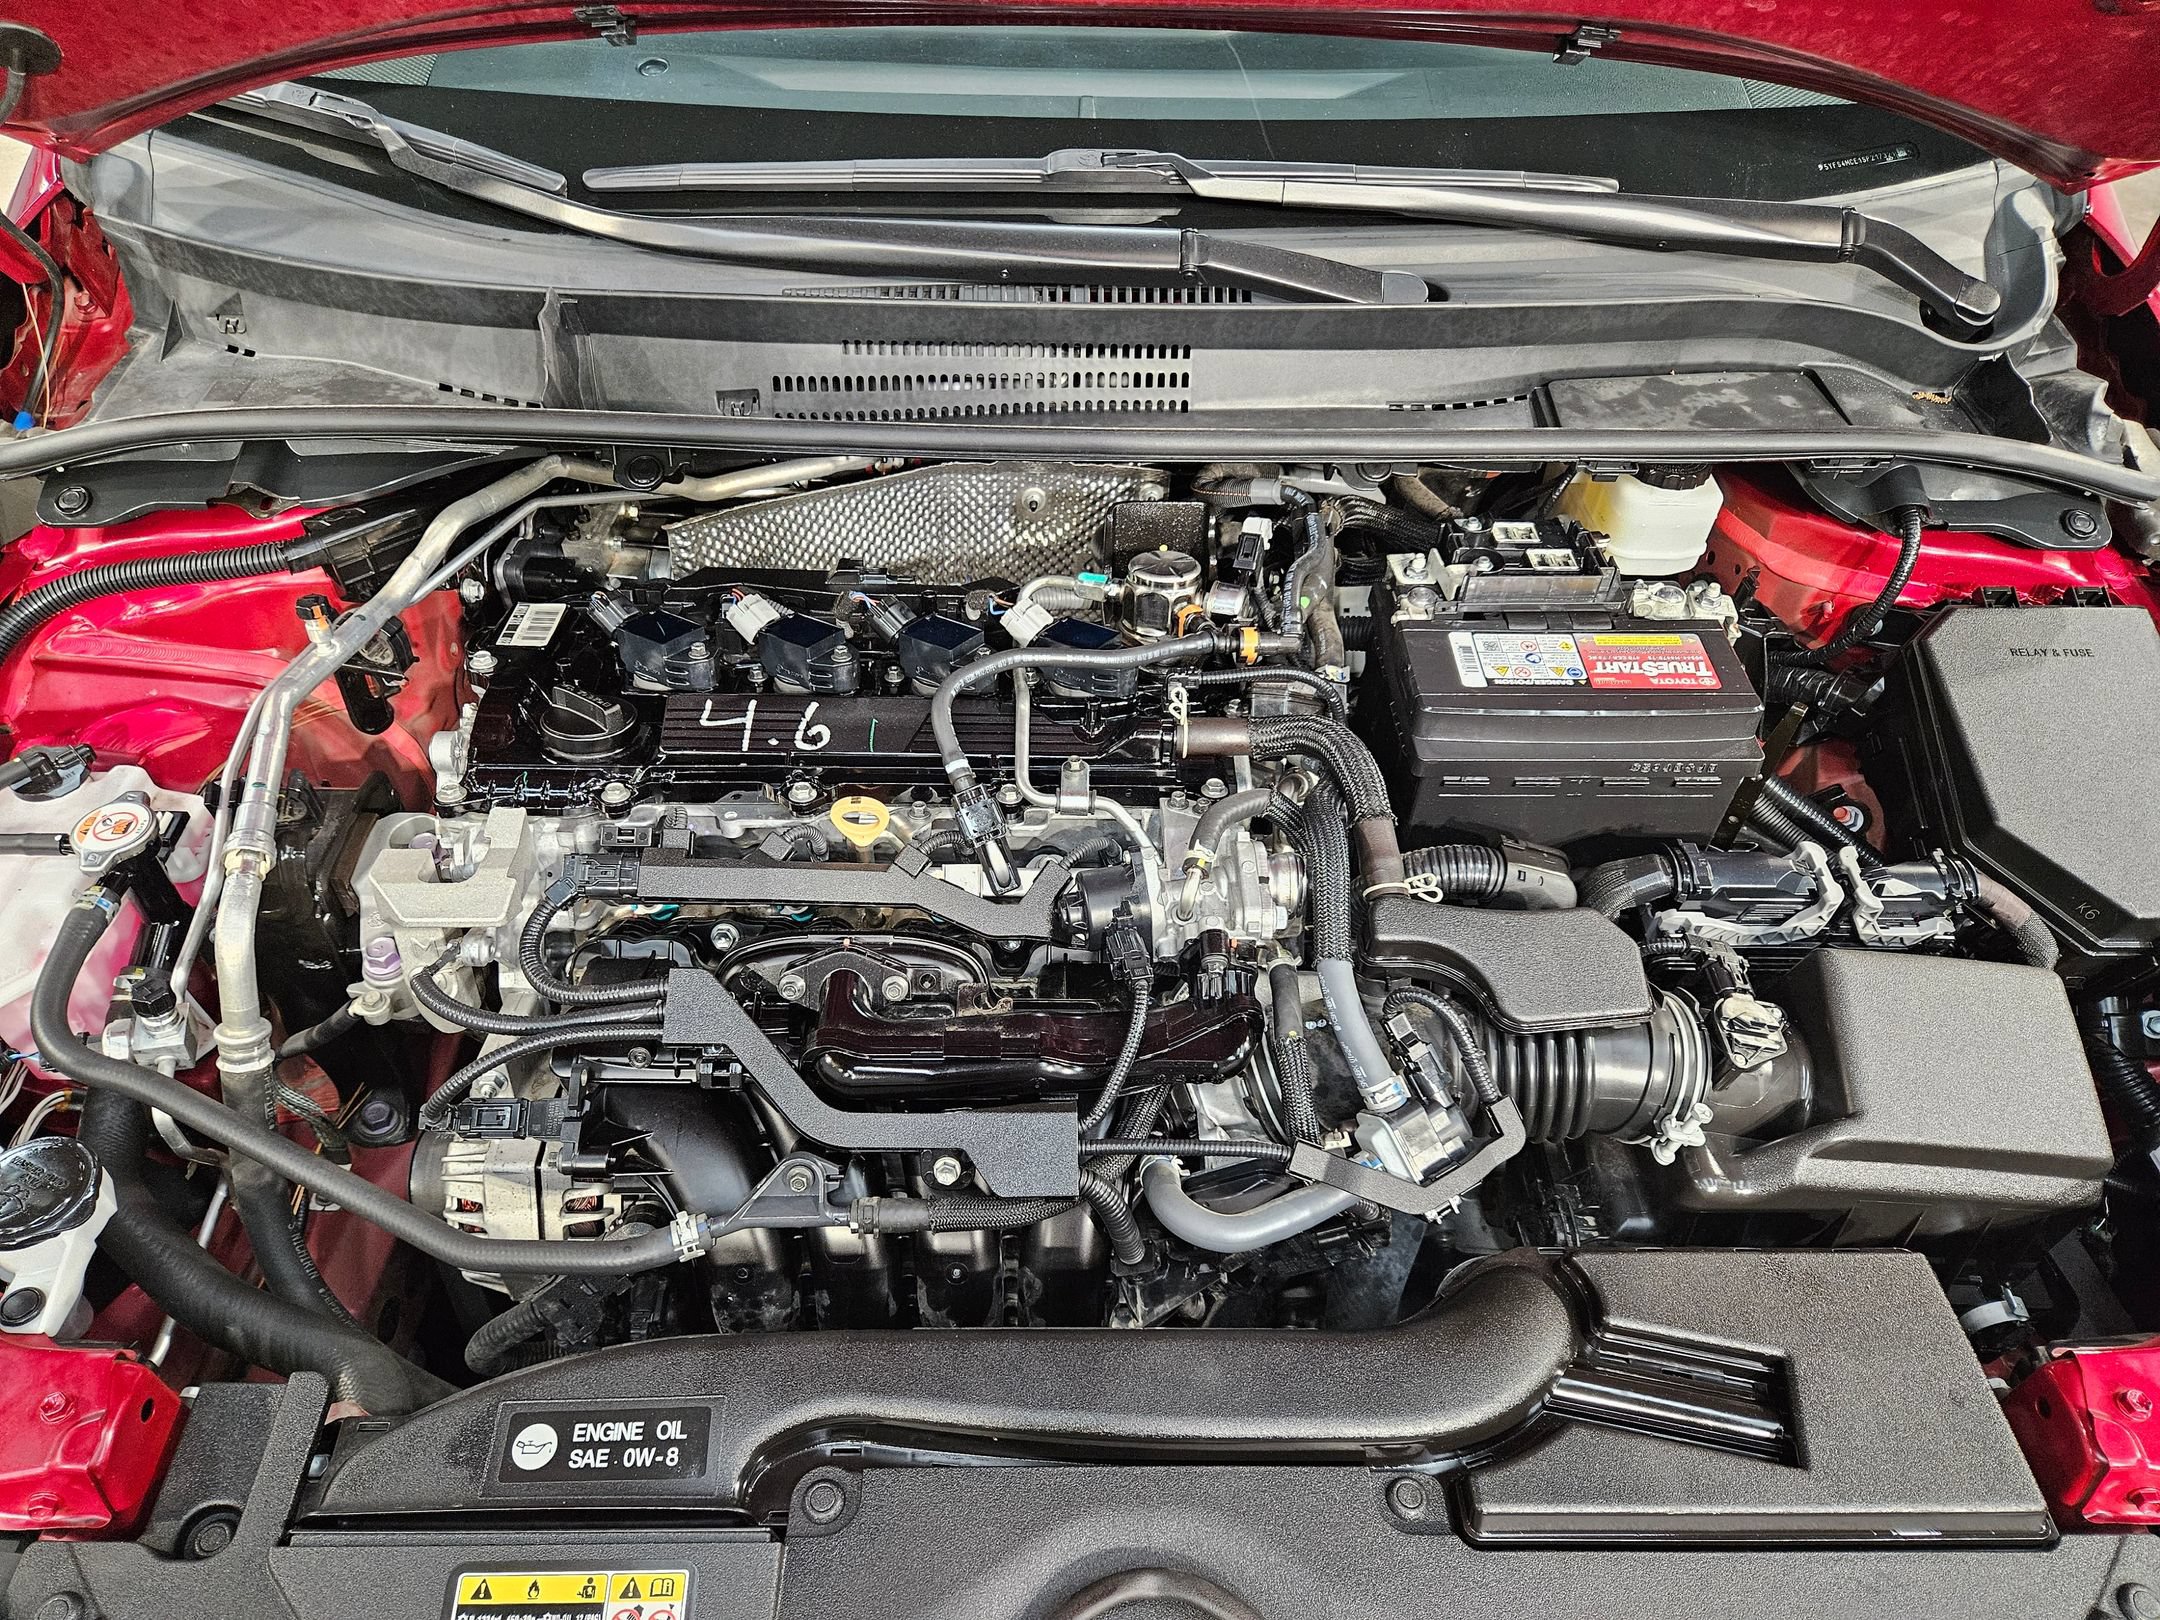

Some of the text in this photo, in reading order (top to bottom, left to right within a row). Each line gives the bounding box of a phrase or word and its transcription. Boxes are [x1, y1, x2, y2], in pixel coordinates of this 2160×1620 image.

[2009, 648, 2095, 658] RELAY & FUSE
[1648, 676, 1698, 686] TOYOTA
[700, 699, 831, 751] 4.6
[2075, 902, 2100, 920] K6
[291, 1232, 320, 1280] NICHIRIN
[572, 1420, 688, 1443] ENGINE OIL
[568, 1447, 679, 1468] SAE 0W-8
